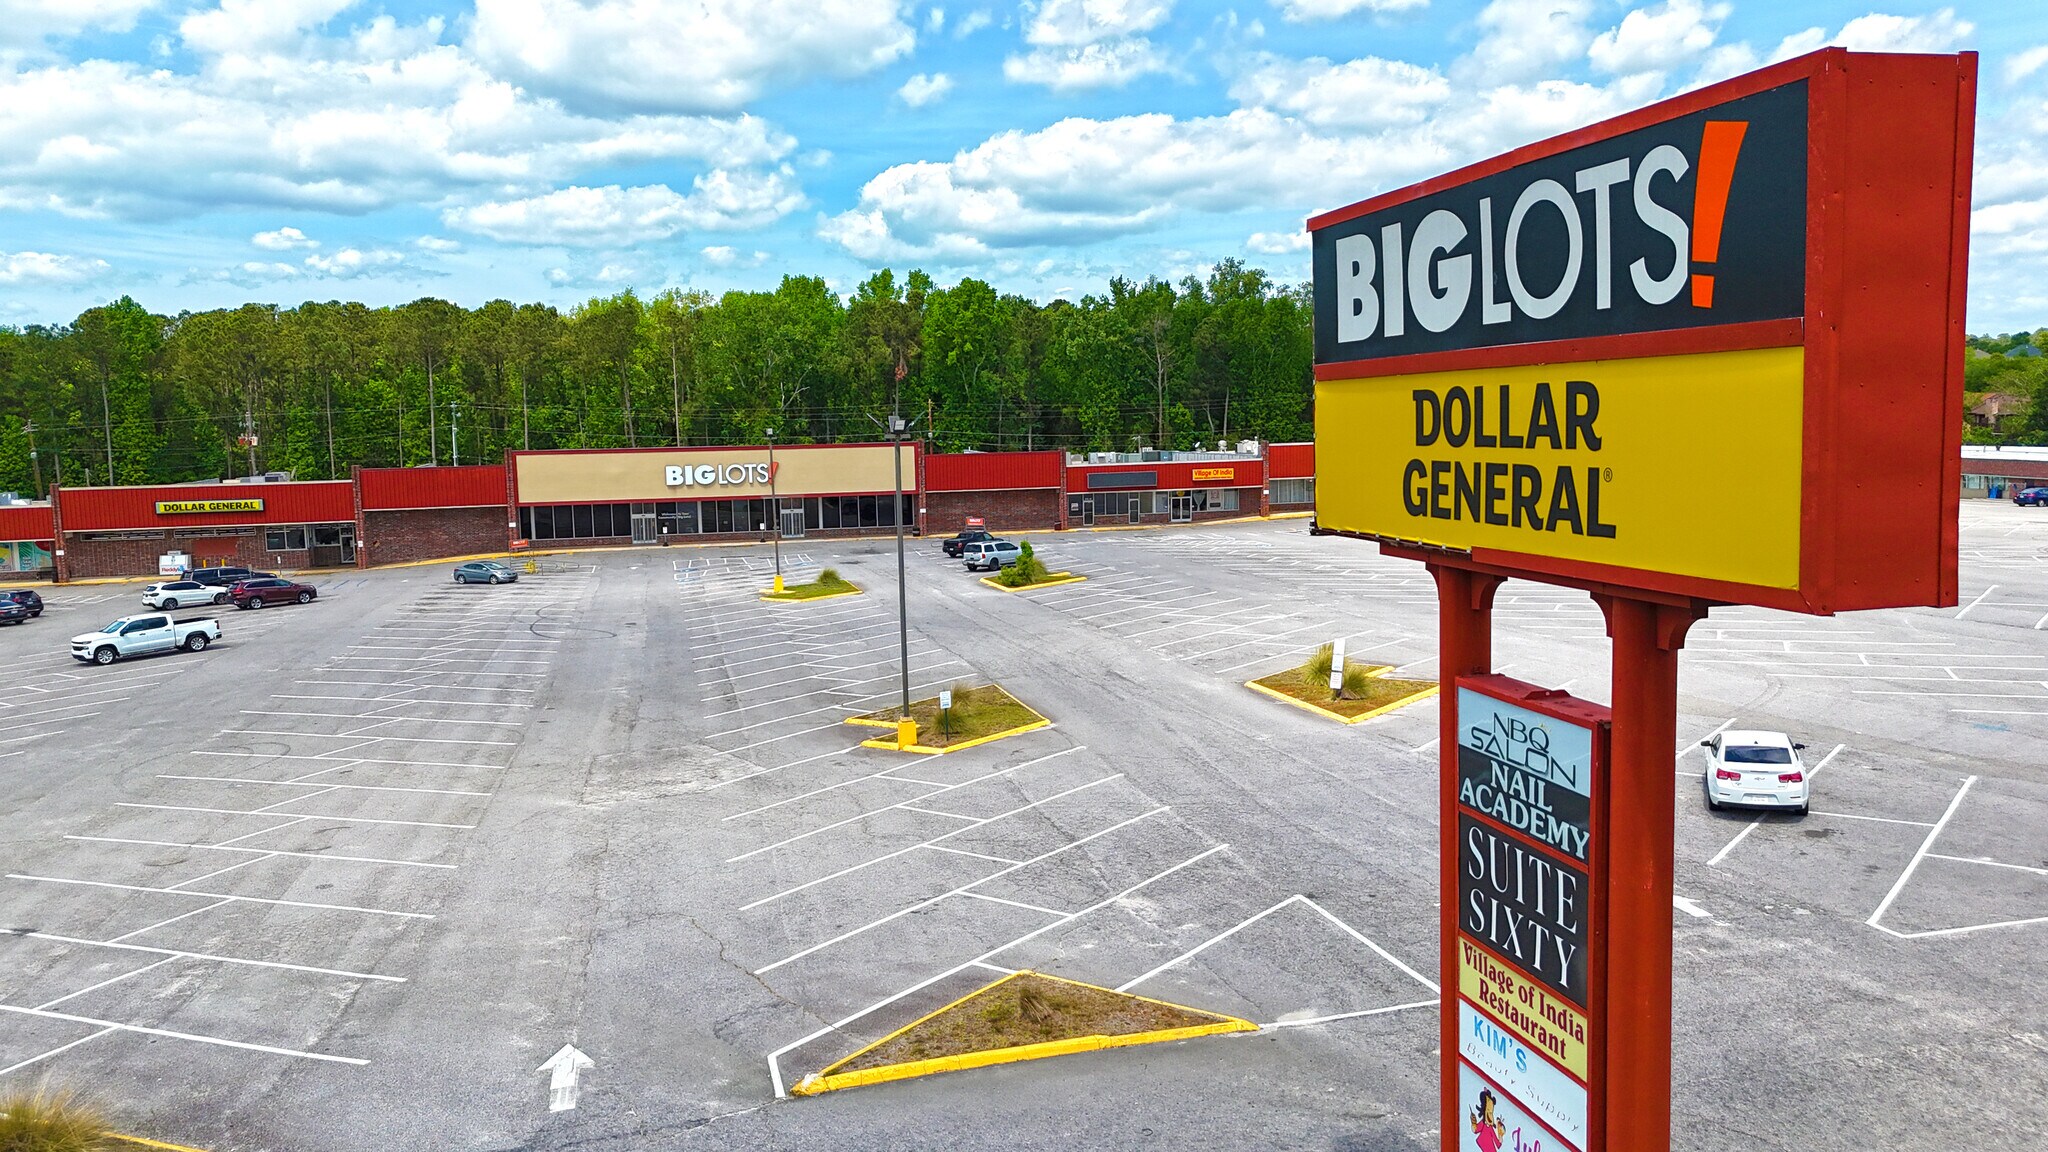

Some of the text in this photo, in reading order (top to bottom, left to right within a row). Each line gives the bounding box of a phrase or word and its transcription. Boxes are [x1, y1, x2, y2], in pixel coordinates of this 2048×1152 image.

[1412, 381, 1602, 452] DOLLAR
[163, 501, 257, 512] DOLLAR GENERAL
[1471, 726, 1577, 789] SALON
[1494, 712, 1549, 753] NBQ
[1459, 777, 1590, 860] ACADEMY
[1490, 760, 1553, 812] NAIL
[1468, 826, 1577, 934] SUITE
[1468, 888, 1576, 989] SIXTY
[1462, 941, 1584, 1045] Village of India
[1479, 977, 1567, 1060] Restaurant
[1474, 1015, 1527, 1073] KIM'S
